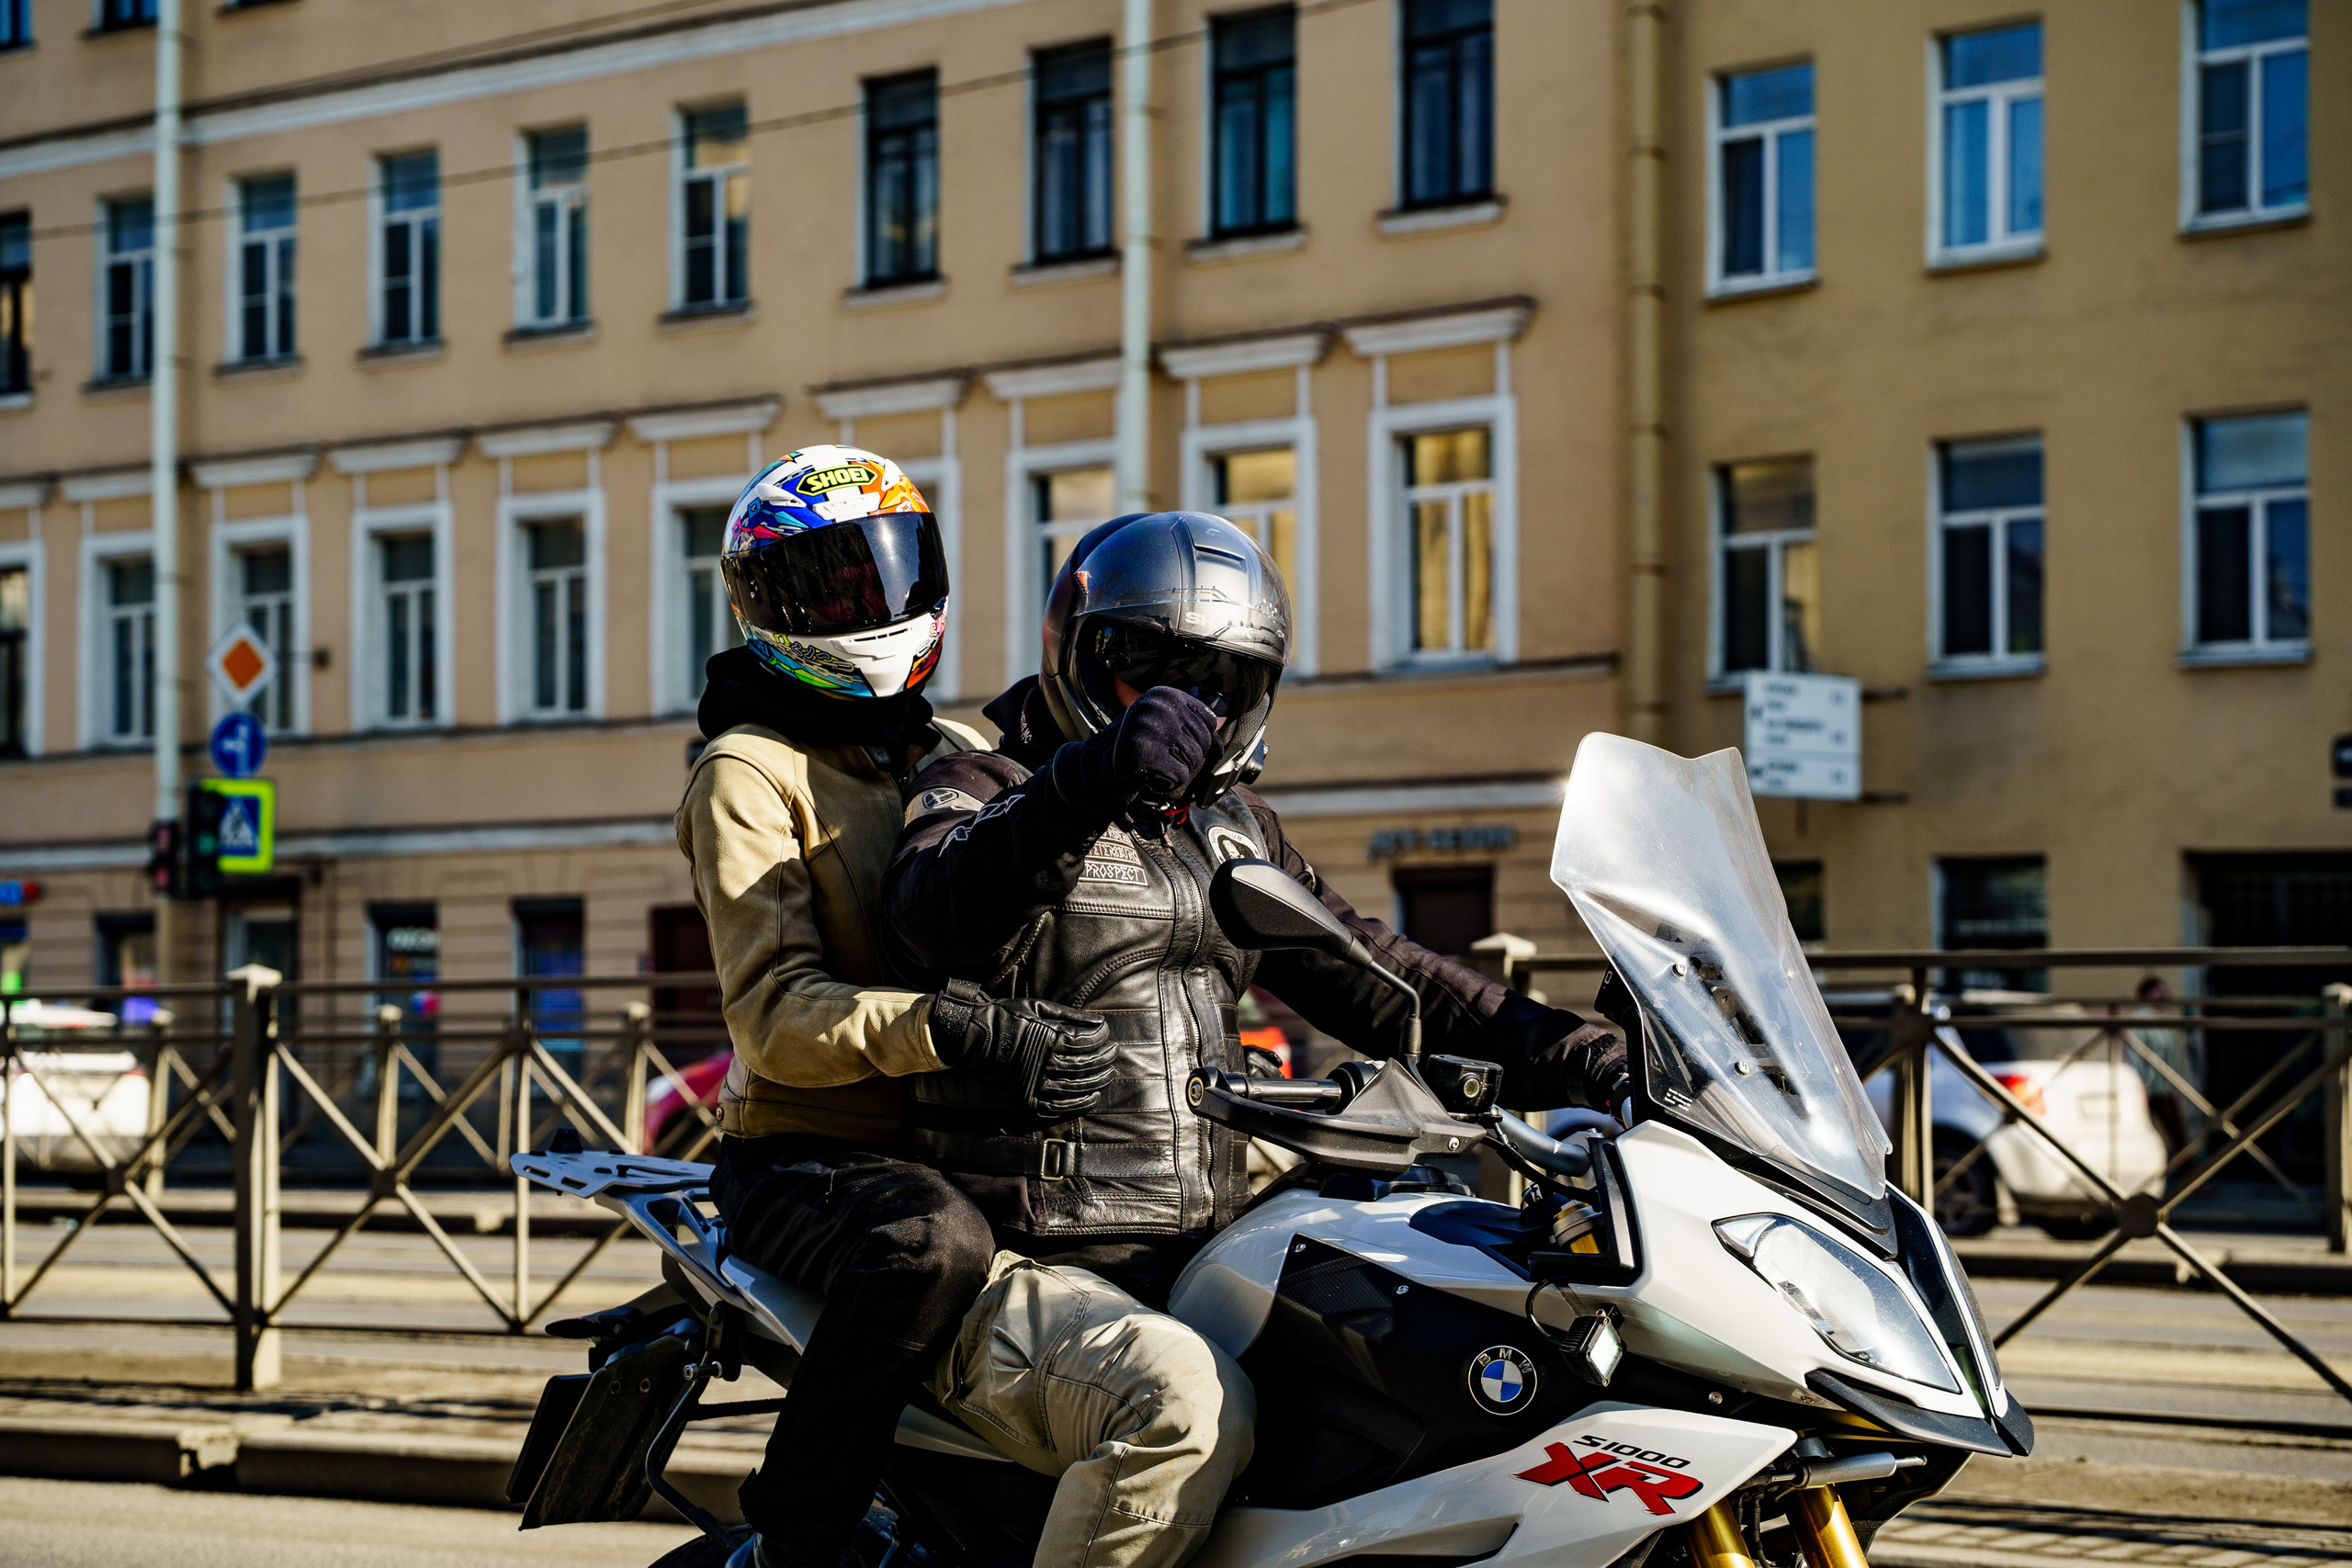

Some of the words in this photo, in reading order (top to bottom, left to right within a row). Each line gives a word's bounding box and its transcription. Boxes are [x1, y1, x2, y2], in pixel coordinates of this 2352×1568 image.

[806, 467, 870, 492] SHOEI
[1085, 863, 1140, 882] PROSPECT
[1477, 1348, 1533, 1375] BMW
[1511, 1440, 1705, 1517] XR
